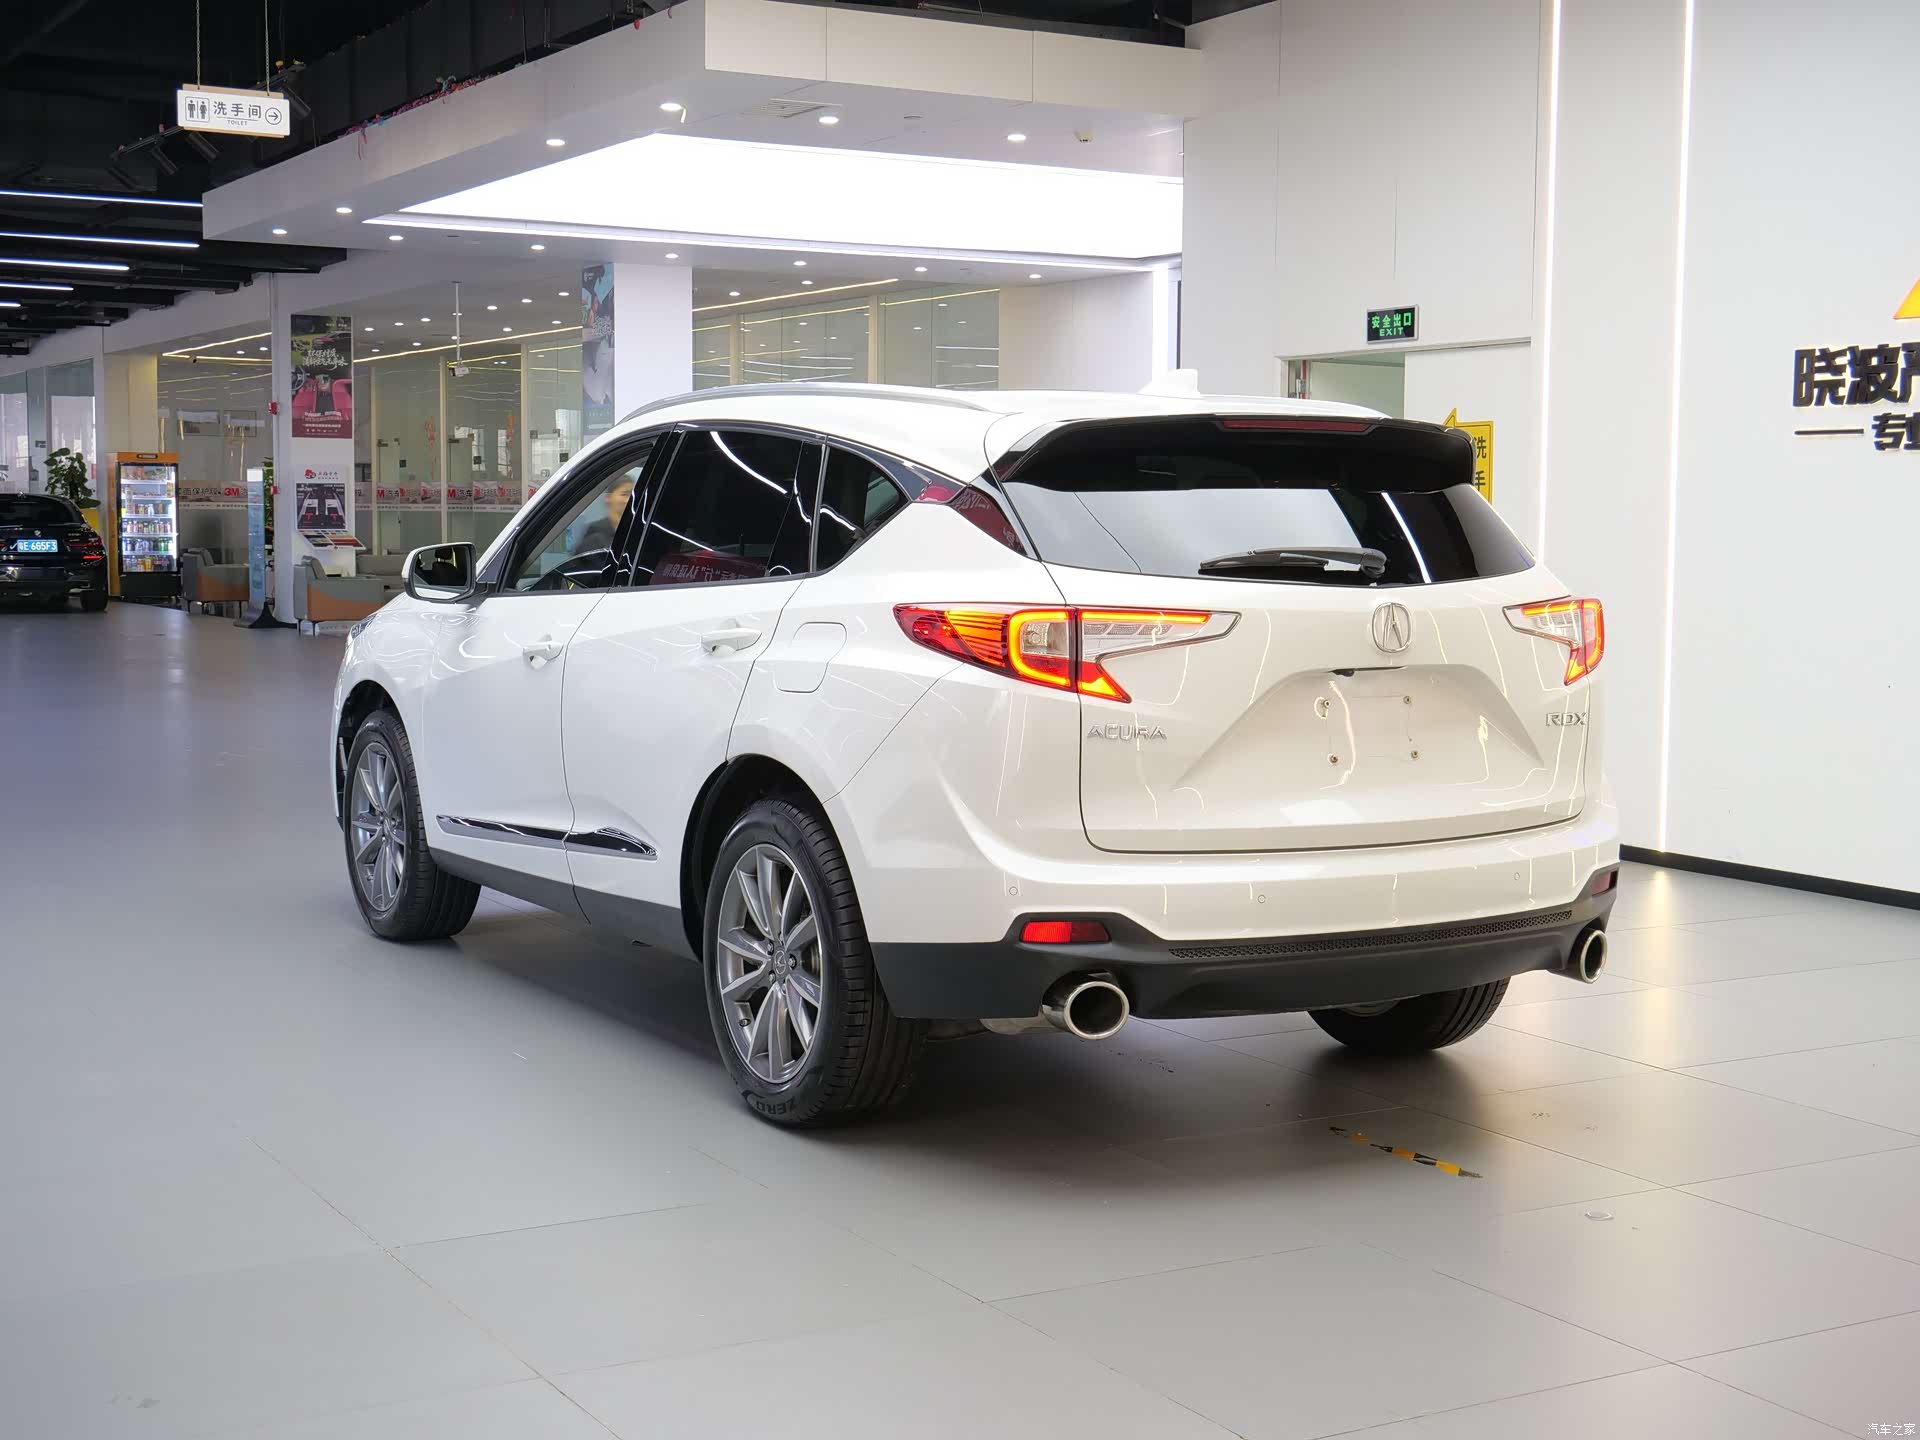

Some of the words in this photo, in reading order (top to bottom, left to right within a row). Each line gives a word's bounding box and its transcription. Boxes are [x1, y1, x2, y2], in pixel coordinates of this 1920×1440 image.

[213, 101, 262, 119] 洗手间
[1371, 312, 1412, 329] 安全出口
[1379, 326, 1404, 337] EXIT
[224, 487, 239, 497] 3M
[1545, 712, 1587, 726] RDX
[1087, 723, 1167, 740] ACURA
